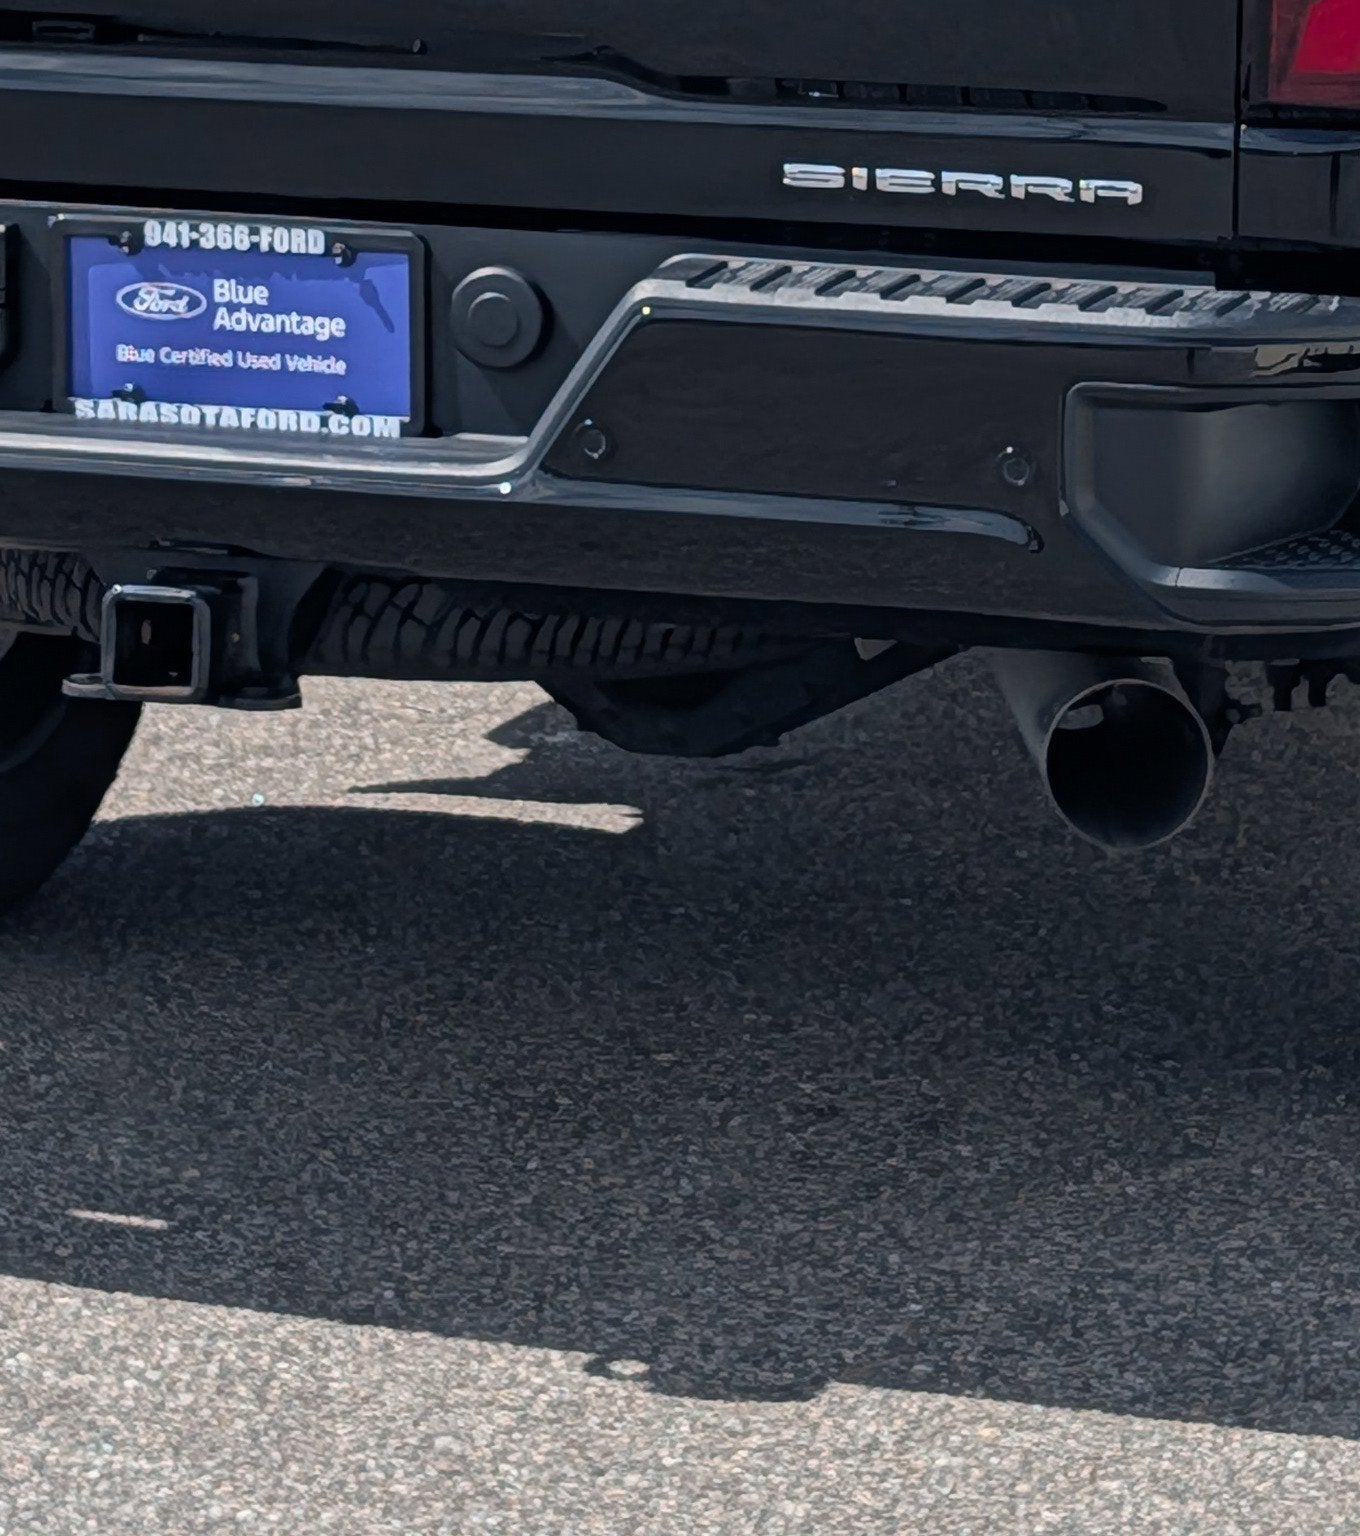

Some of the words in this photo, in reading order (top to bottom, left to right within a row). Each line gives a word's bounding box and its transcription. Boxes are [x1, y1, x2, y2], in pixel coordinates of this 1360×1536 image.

[782, 163, 1144, 206] SIERRA
[143, 219, 326, 255] 941-366-FORD
[134, 285, 190, 315] Ford
[213, 278, 269, 306] Blue
[213, 306, 347, 342] Advantage
[115, 344, 156, 364] Blue
[159, 346, 234, 368] Certified
[237, 350, 282, 371] Used
[285, 353, 348, 376] Vehicle
[73, 396, 402, 439] SARASOTAFORD.COM
